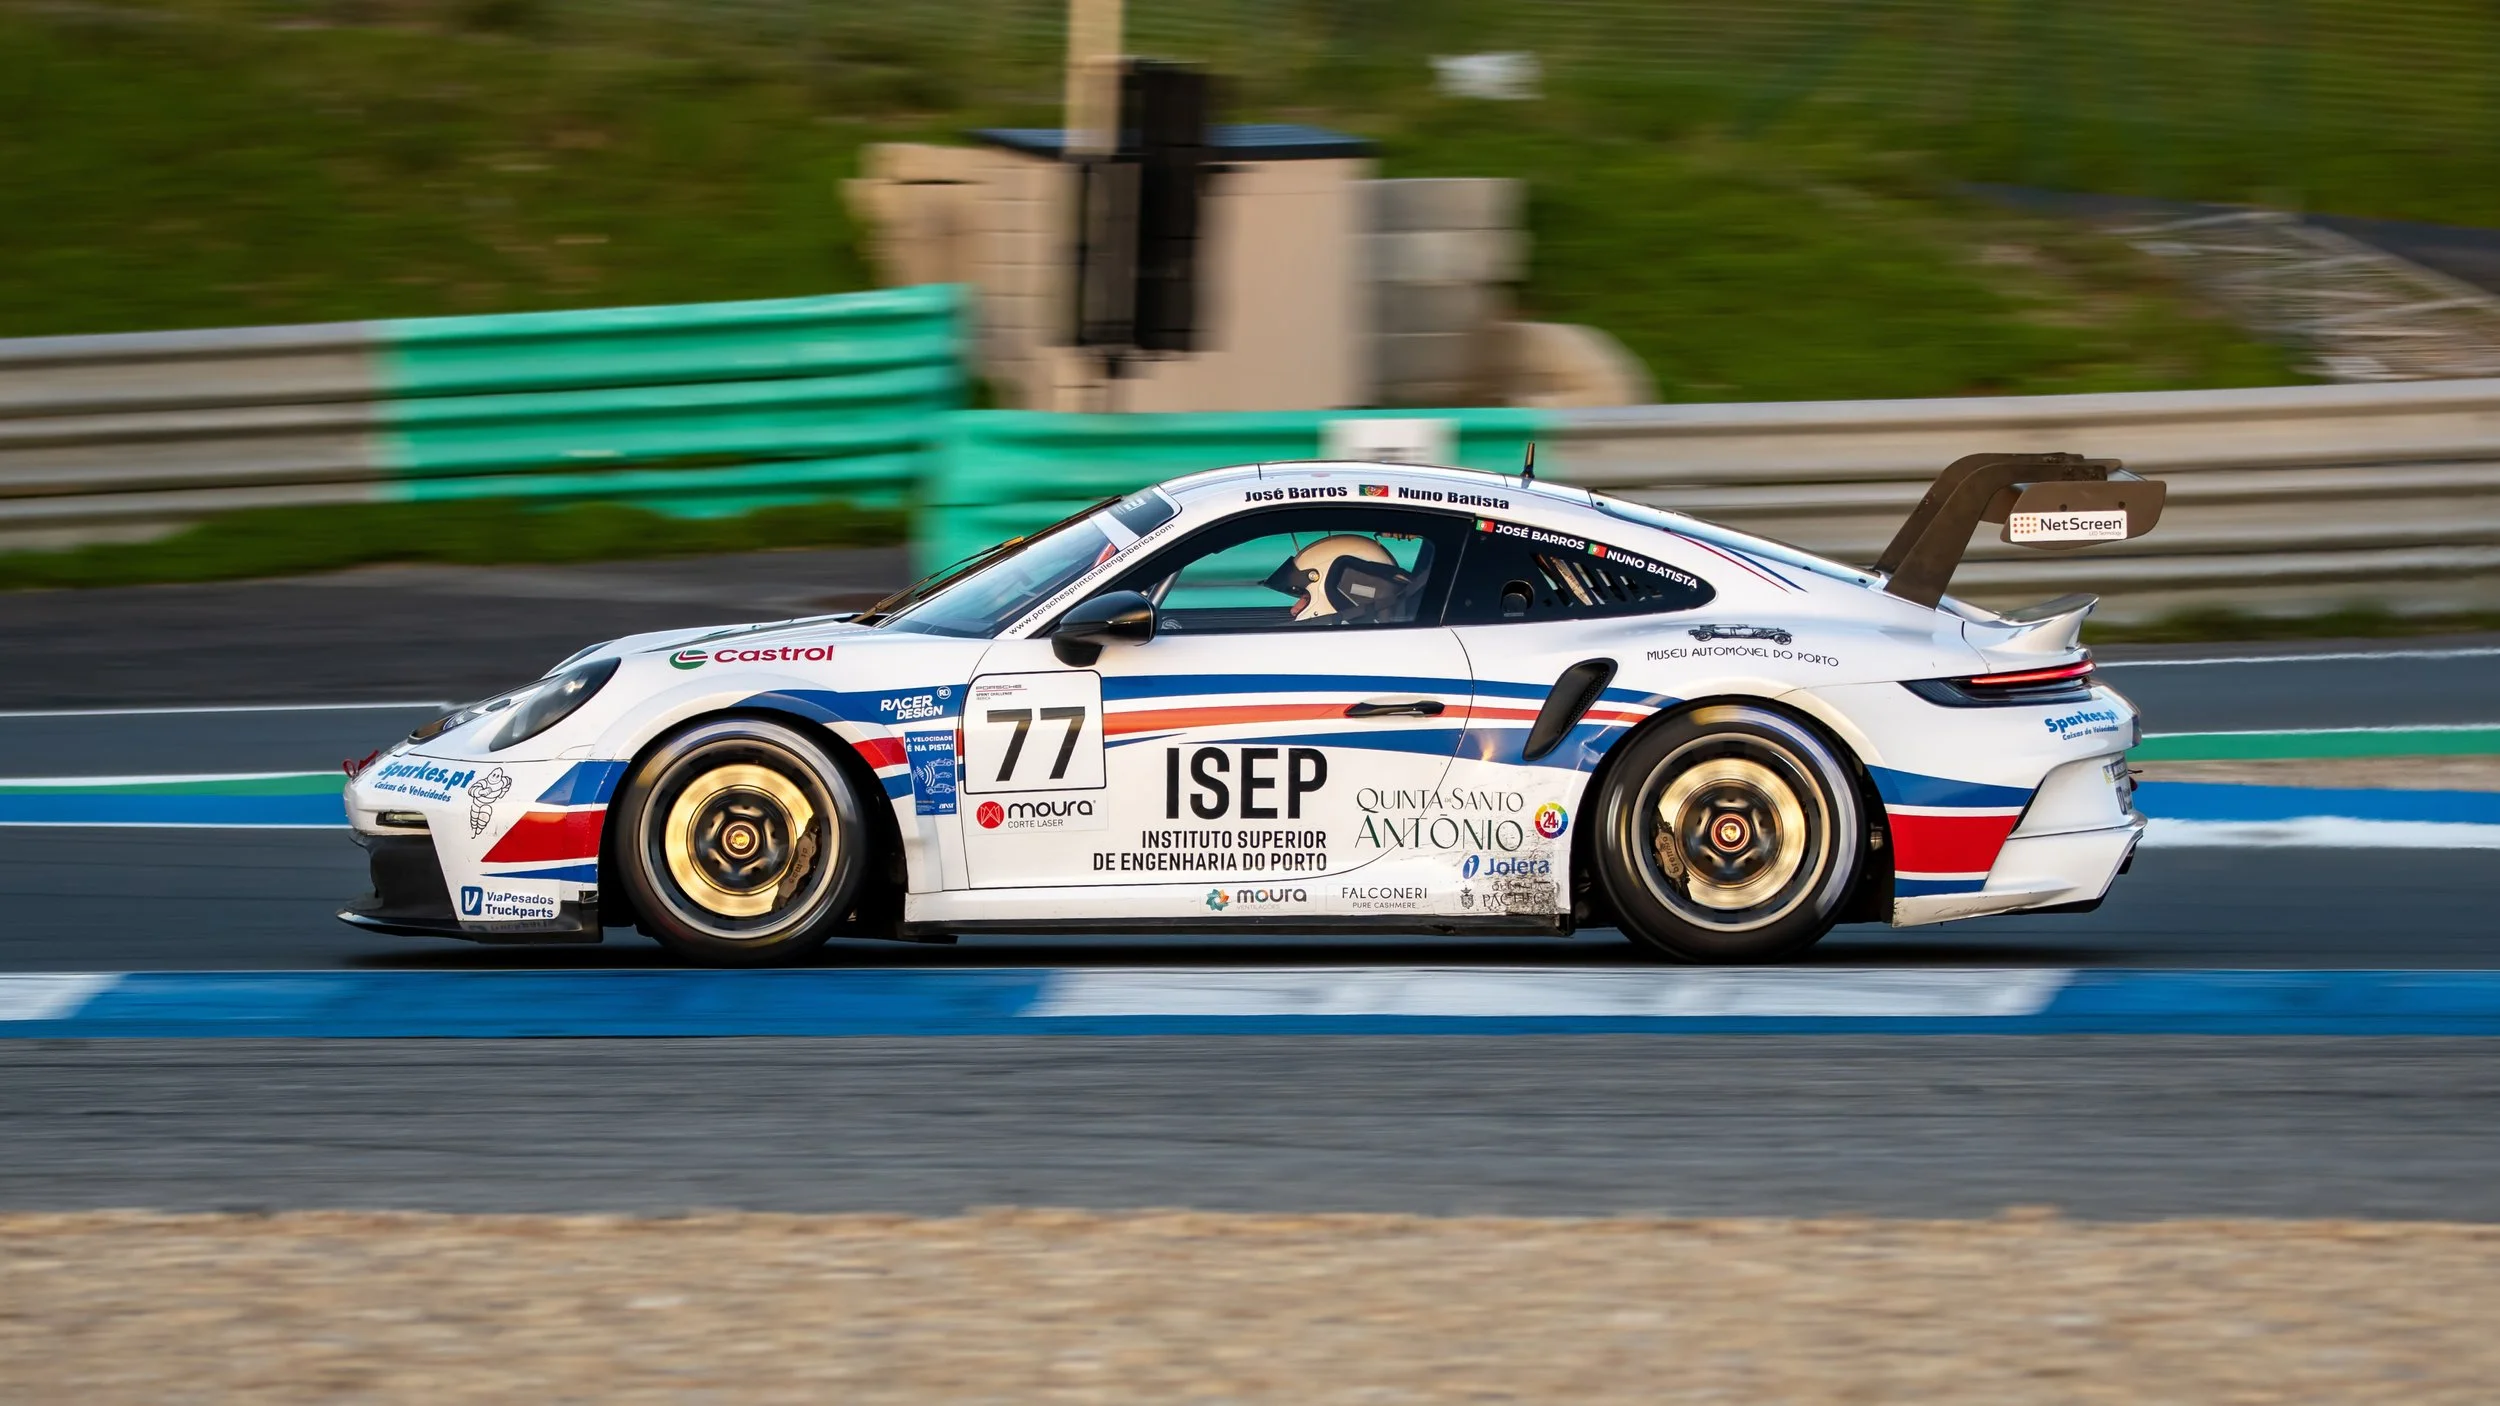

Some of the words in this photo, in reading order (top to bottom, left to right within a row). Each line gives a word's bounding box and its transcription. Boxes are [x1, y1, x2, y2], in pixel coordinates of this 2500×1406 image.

[1244, 487, 1284, 502] José
[1288, 486, 1348, 499] Barros
[1398, 487, 1443, 502] Nuno
[1447, 491, 1509, 510] Batista
[2040, 517, 2122, 531] NetScreen
[1495, 524, 1528, 539] JOSÉ
[1531, 531, 1585, 550] BARROS
[1606, 550, 1645, 569] NUNO
[1647, 562, 1698, 589] BATISTA
[1008, 522, 1175, 636] www.porschesprintchallengeiberica.com
[714, 645, 834, 663] Castrol
[1647, 648, 1687, 661] MUSEU
[1691, 645, 1769, 658] AUTOMÓVEL
[1773, 650, 1793, 660] DO
[1798, 652, 1839, 667] PORTO
[880, 694, 933, 712] RACER
[896, 704, 944, 720] DESIGN
[912, 735, 953, 743] VELOCIDADE
[914, 744, 927, 752] NA
[929, 743, 954, 752] PISTA!
[987, 706, 1085, 782] 77
[374, 781, 397, 792] Caixas
[397, 783, 408, 794] de
[408, 785, 452, 802] Velocidades
[1166, 747, 1328, 820] ISEP
[1356, 787, 1443, 813] QUINTA
[1451, 787, 1524, 813] SANTO
[1008, 800, 1093, 819] moura
[1007, 820, 1035, 829] CORTE
[1037, 819, 1064, 828] LASER
[1142, 830, 1232, 849] INSTITUTO
[1237, 830, 1327, 849] SUPERIOR
[1093, 852, 1116, 871] DE
[1121, 852, 1237, 871] ENGENHARIA
[1243, 852, 1265, 871] DO
[1271, 852, 1327, 871] PORTO
[1484, 857, 1549, 876] Jolera
[487, 891, 554, 905] ViaPesados
[1237, 888, 1307, 903] moura
[1342, 887, 1427, 899] FALCONERI
[485, 903, 554, 918] Truckparts
[1373, 901, 1416, 909] CASHMERE
